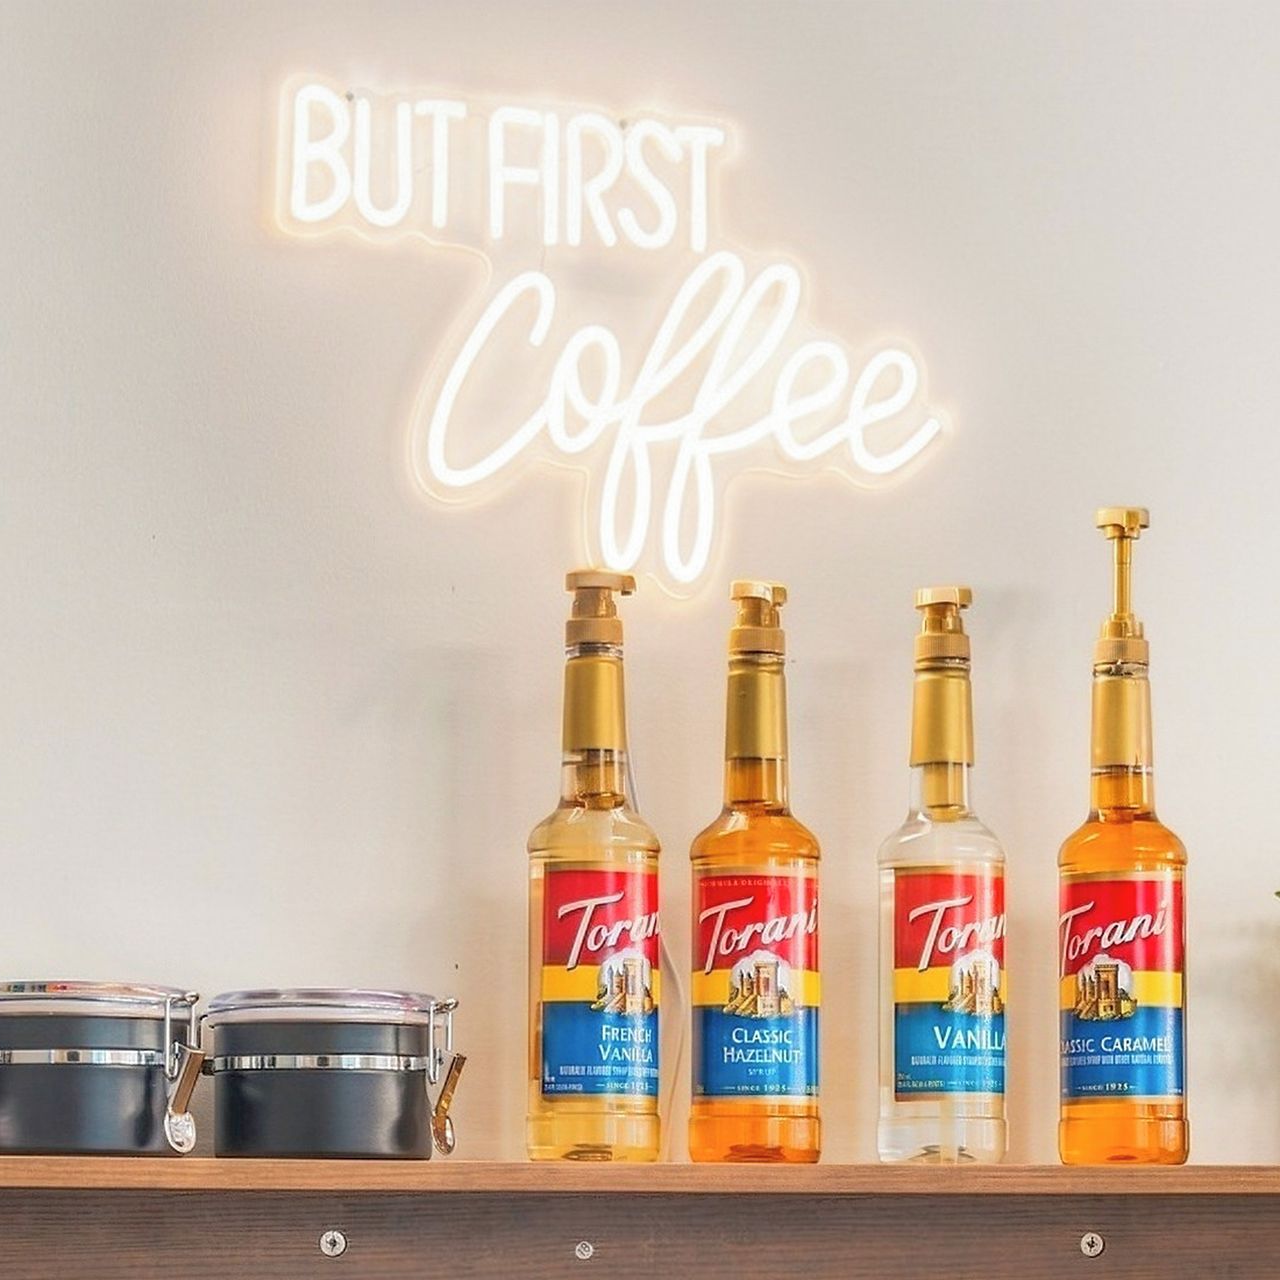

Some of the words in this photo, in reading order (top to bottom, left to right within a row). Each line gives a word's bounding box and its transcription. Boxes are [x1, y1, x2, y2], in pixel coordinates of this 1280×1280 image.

[290, 84, 466, 229] BUT
[488, 104, 726, 254] FIRST
[427, 250, 943, 583] Coffee
[698, 896, 818, 976] Torani
[1060, 901, 1168, 980] Torani
[602, 1024, 652, 1043] FRENCH
[732, 1027, 793, 1044] CLASSIC
[599, 1043, 653, 1063] VANILLA
[1101, 1036, 1171, 1052] CARAMEL
[723, 1046, 801, 1063] HAZELNUT
[763, 1084, 787, 1092] 1925
[1105, 1083, 1129, 1091] 1925
